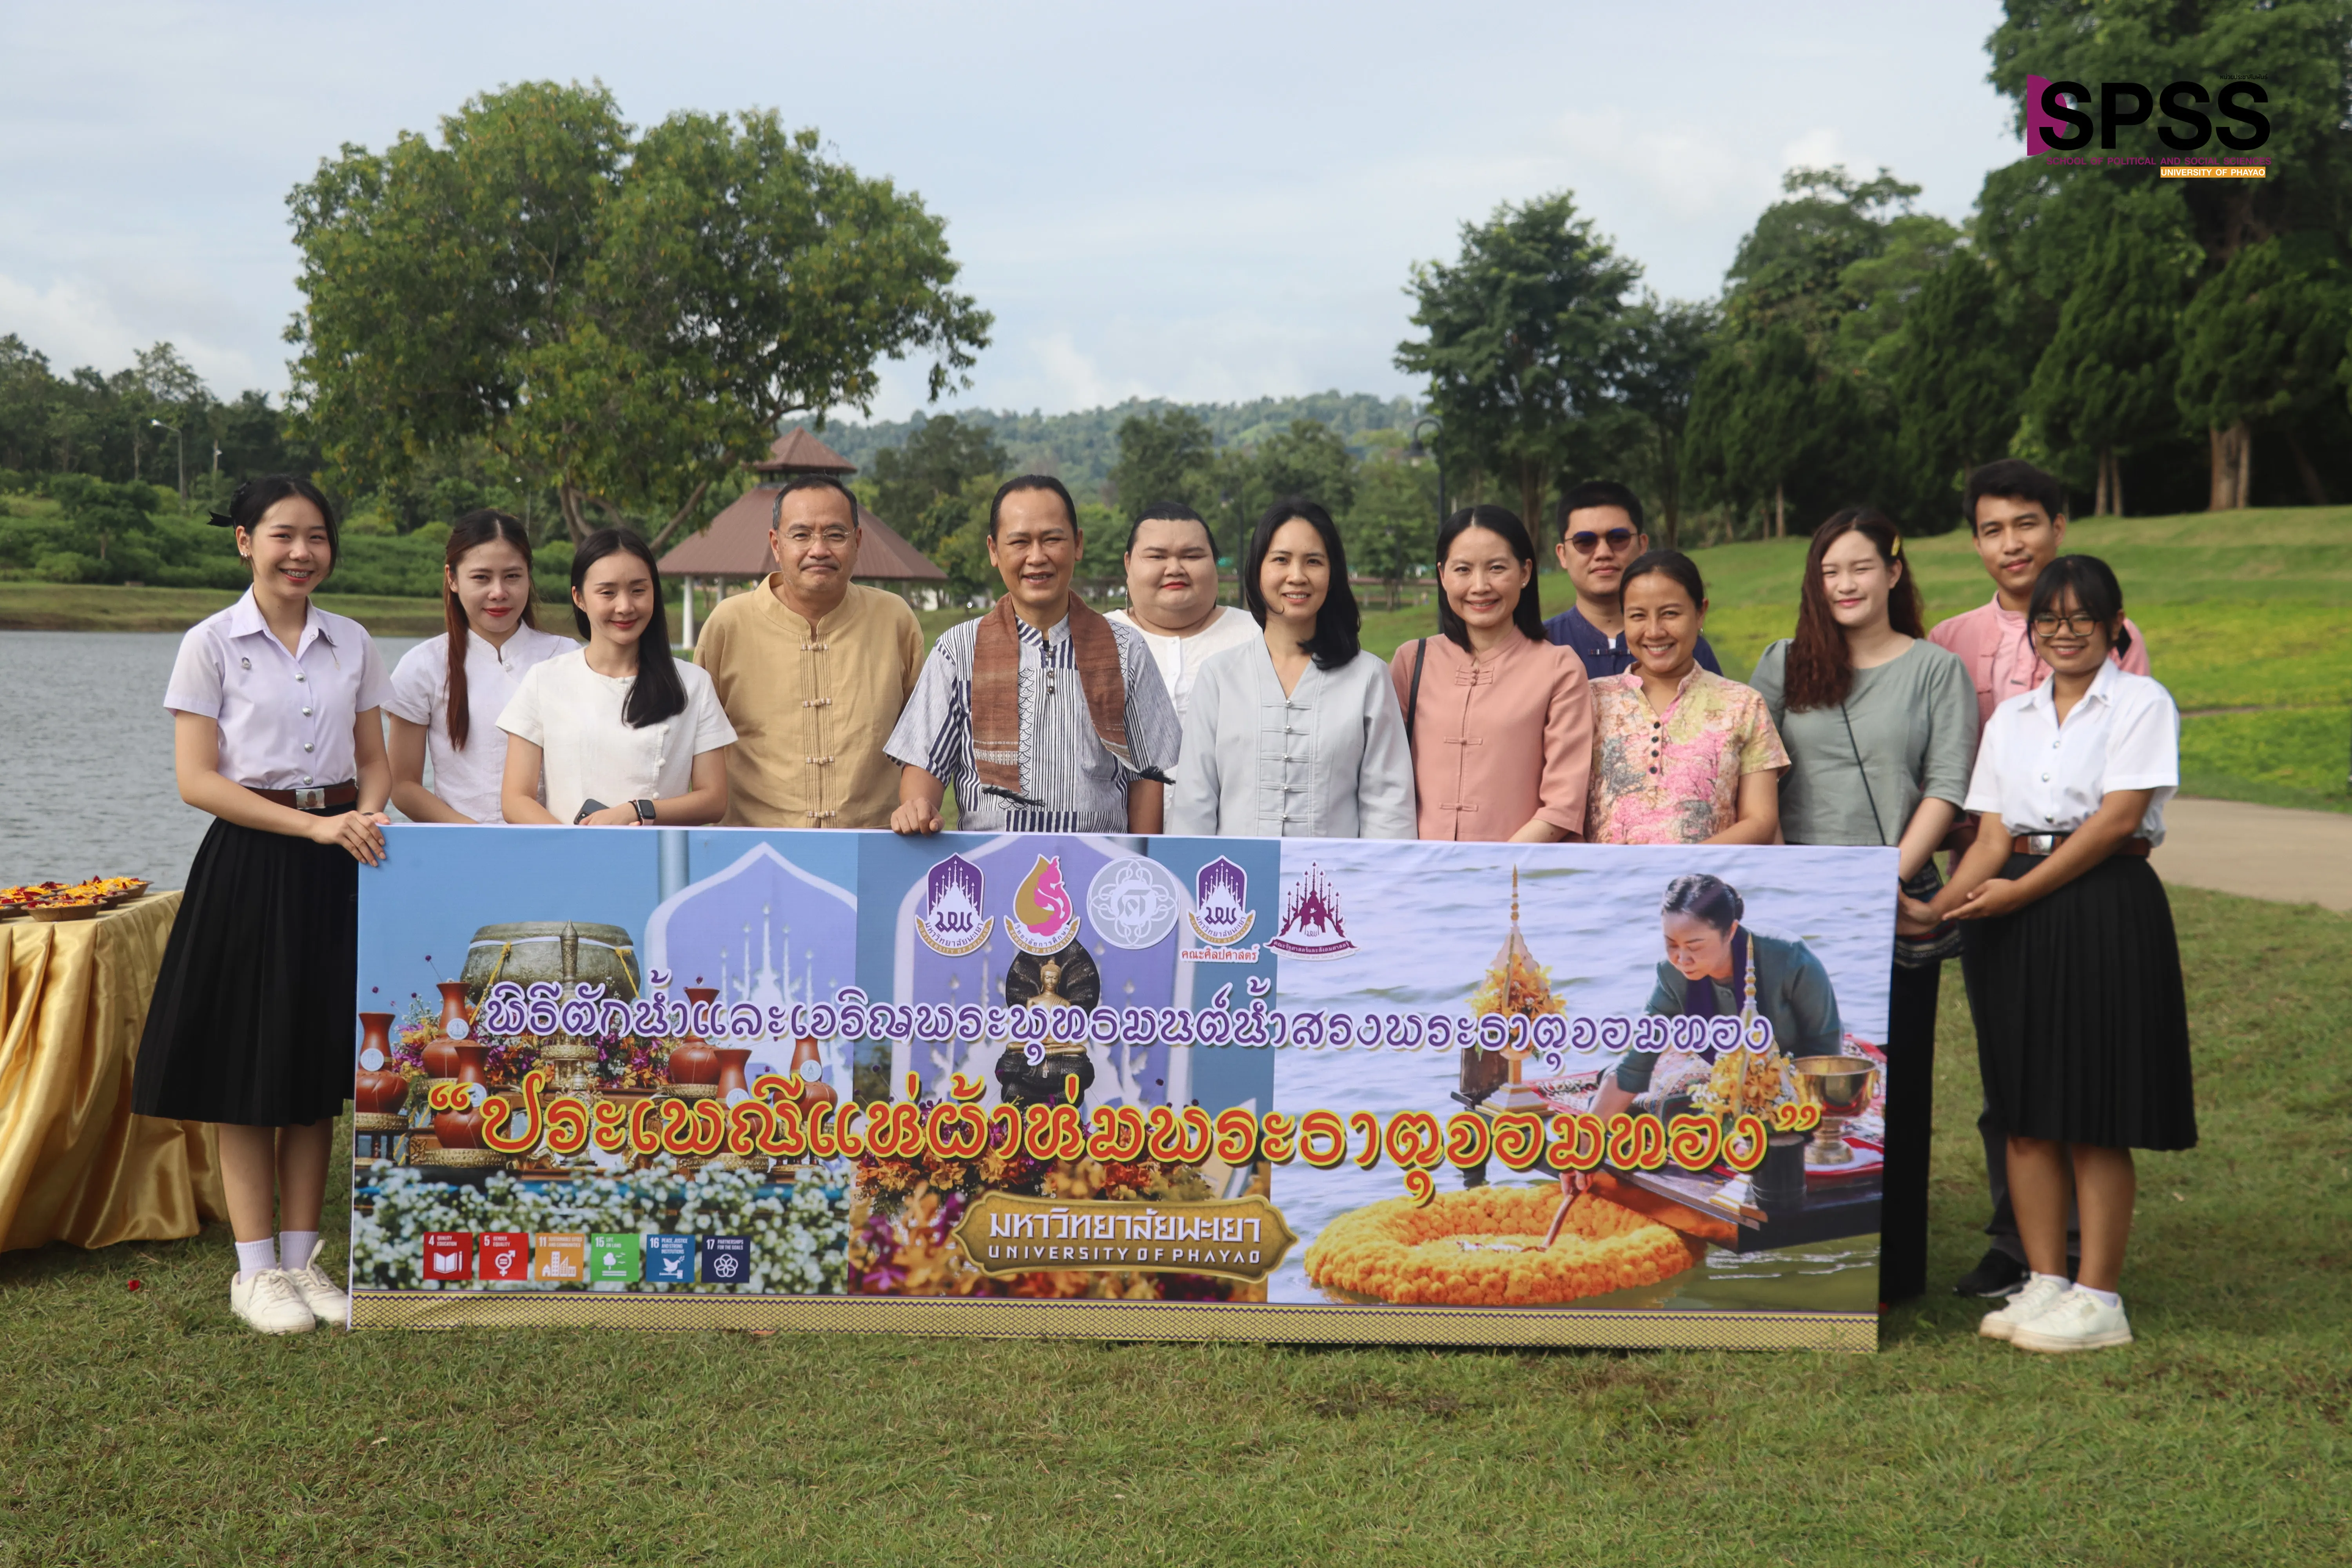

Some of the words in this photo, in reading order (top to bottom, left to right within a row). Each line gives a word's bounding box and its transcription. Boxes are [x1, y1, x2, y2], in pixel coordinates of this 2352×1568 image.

[919, 927, 954, 953] UNIVERSITY
[969, 927, 989, 949] PHAYAO
[1009, 929, 1028, 950] SCHOOL
[1043, 930, 1074, 953] EDUCATION
[1181, 946, 1258, 960] คณะศิลปศาสตร์
[989, 1207, 1261, 1243] มหาวิทยาลัยพะเยา
[428, 1235, 434, 1246] 4
[484, 1235, 490, 1246] 5
[539, 1236, 547, 1247] 11
[595, 1236, 604, 1247] 15
[650, 1238, 659, 1248] 16
[706, 1239, 715, 1250] 17
[988, 1245, 1129, 1261] UNIVERSITY
[1138, 1247, 1164, 1261] OF
[1173, 1249, 1261, 1264] PHAYAO
